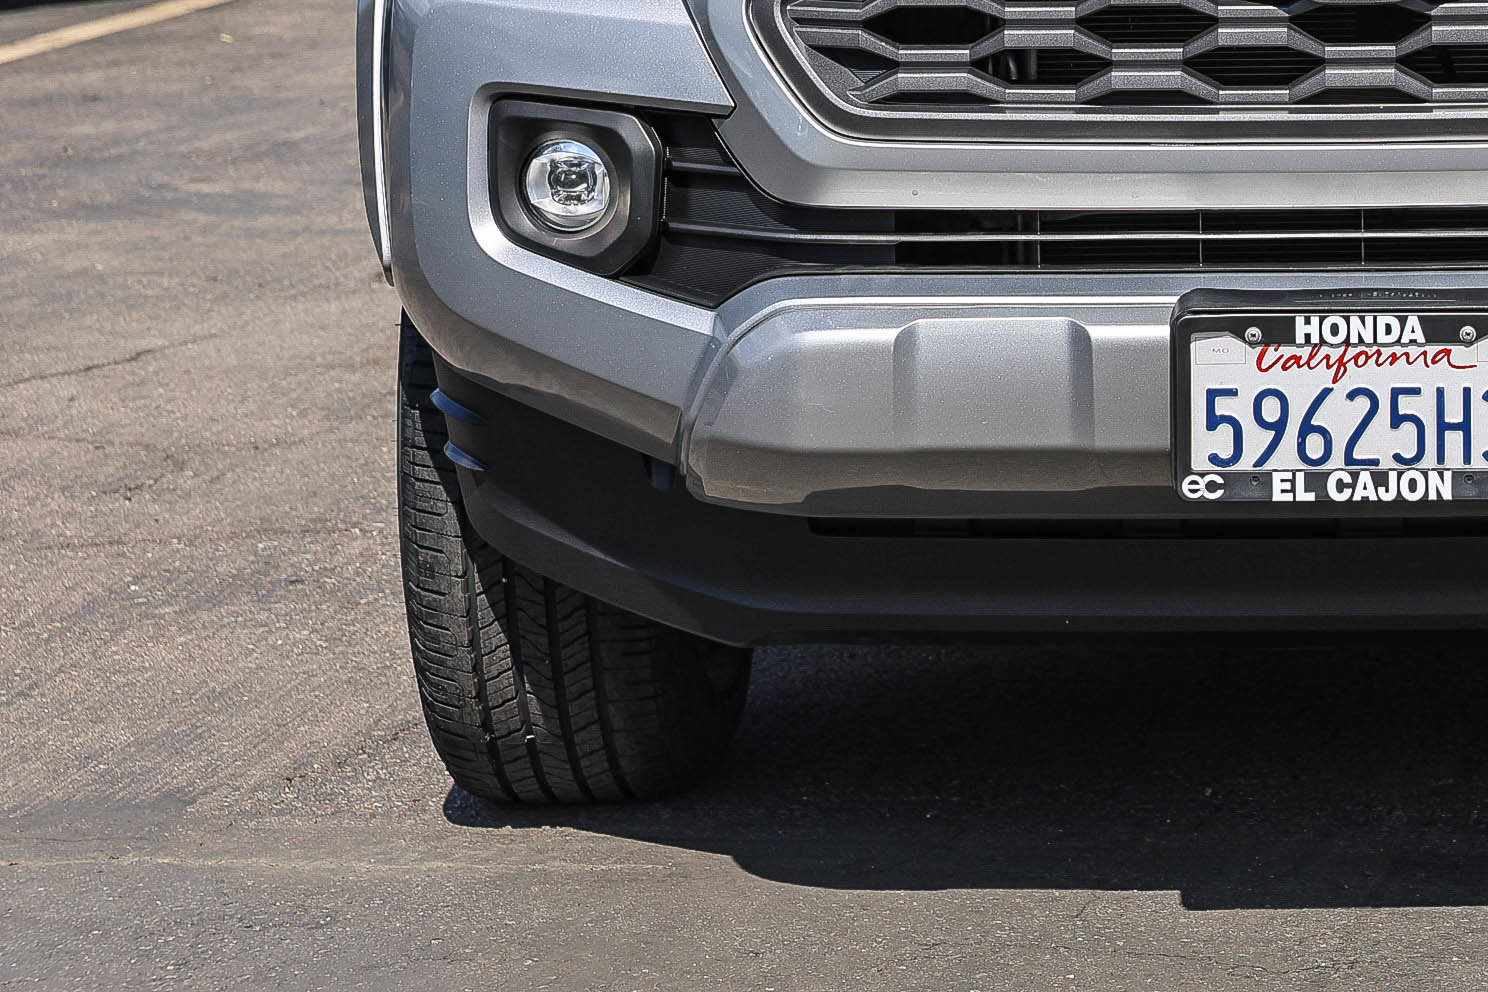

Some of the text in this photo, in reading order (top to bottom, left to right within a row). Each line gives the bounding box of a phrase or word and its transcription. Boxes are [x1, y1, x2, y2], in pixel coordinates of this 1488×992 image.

[1295, 315, 1427, 345] HONDA
[1256, 342, 1478, 385] California
[1271, 469, 1453, 503] EL CAJON
